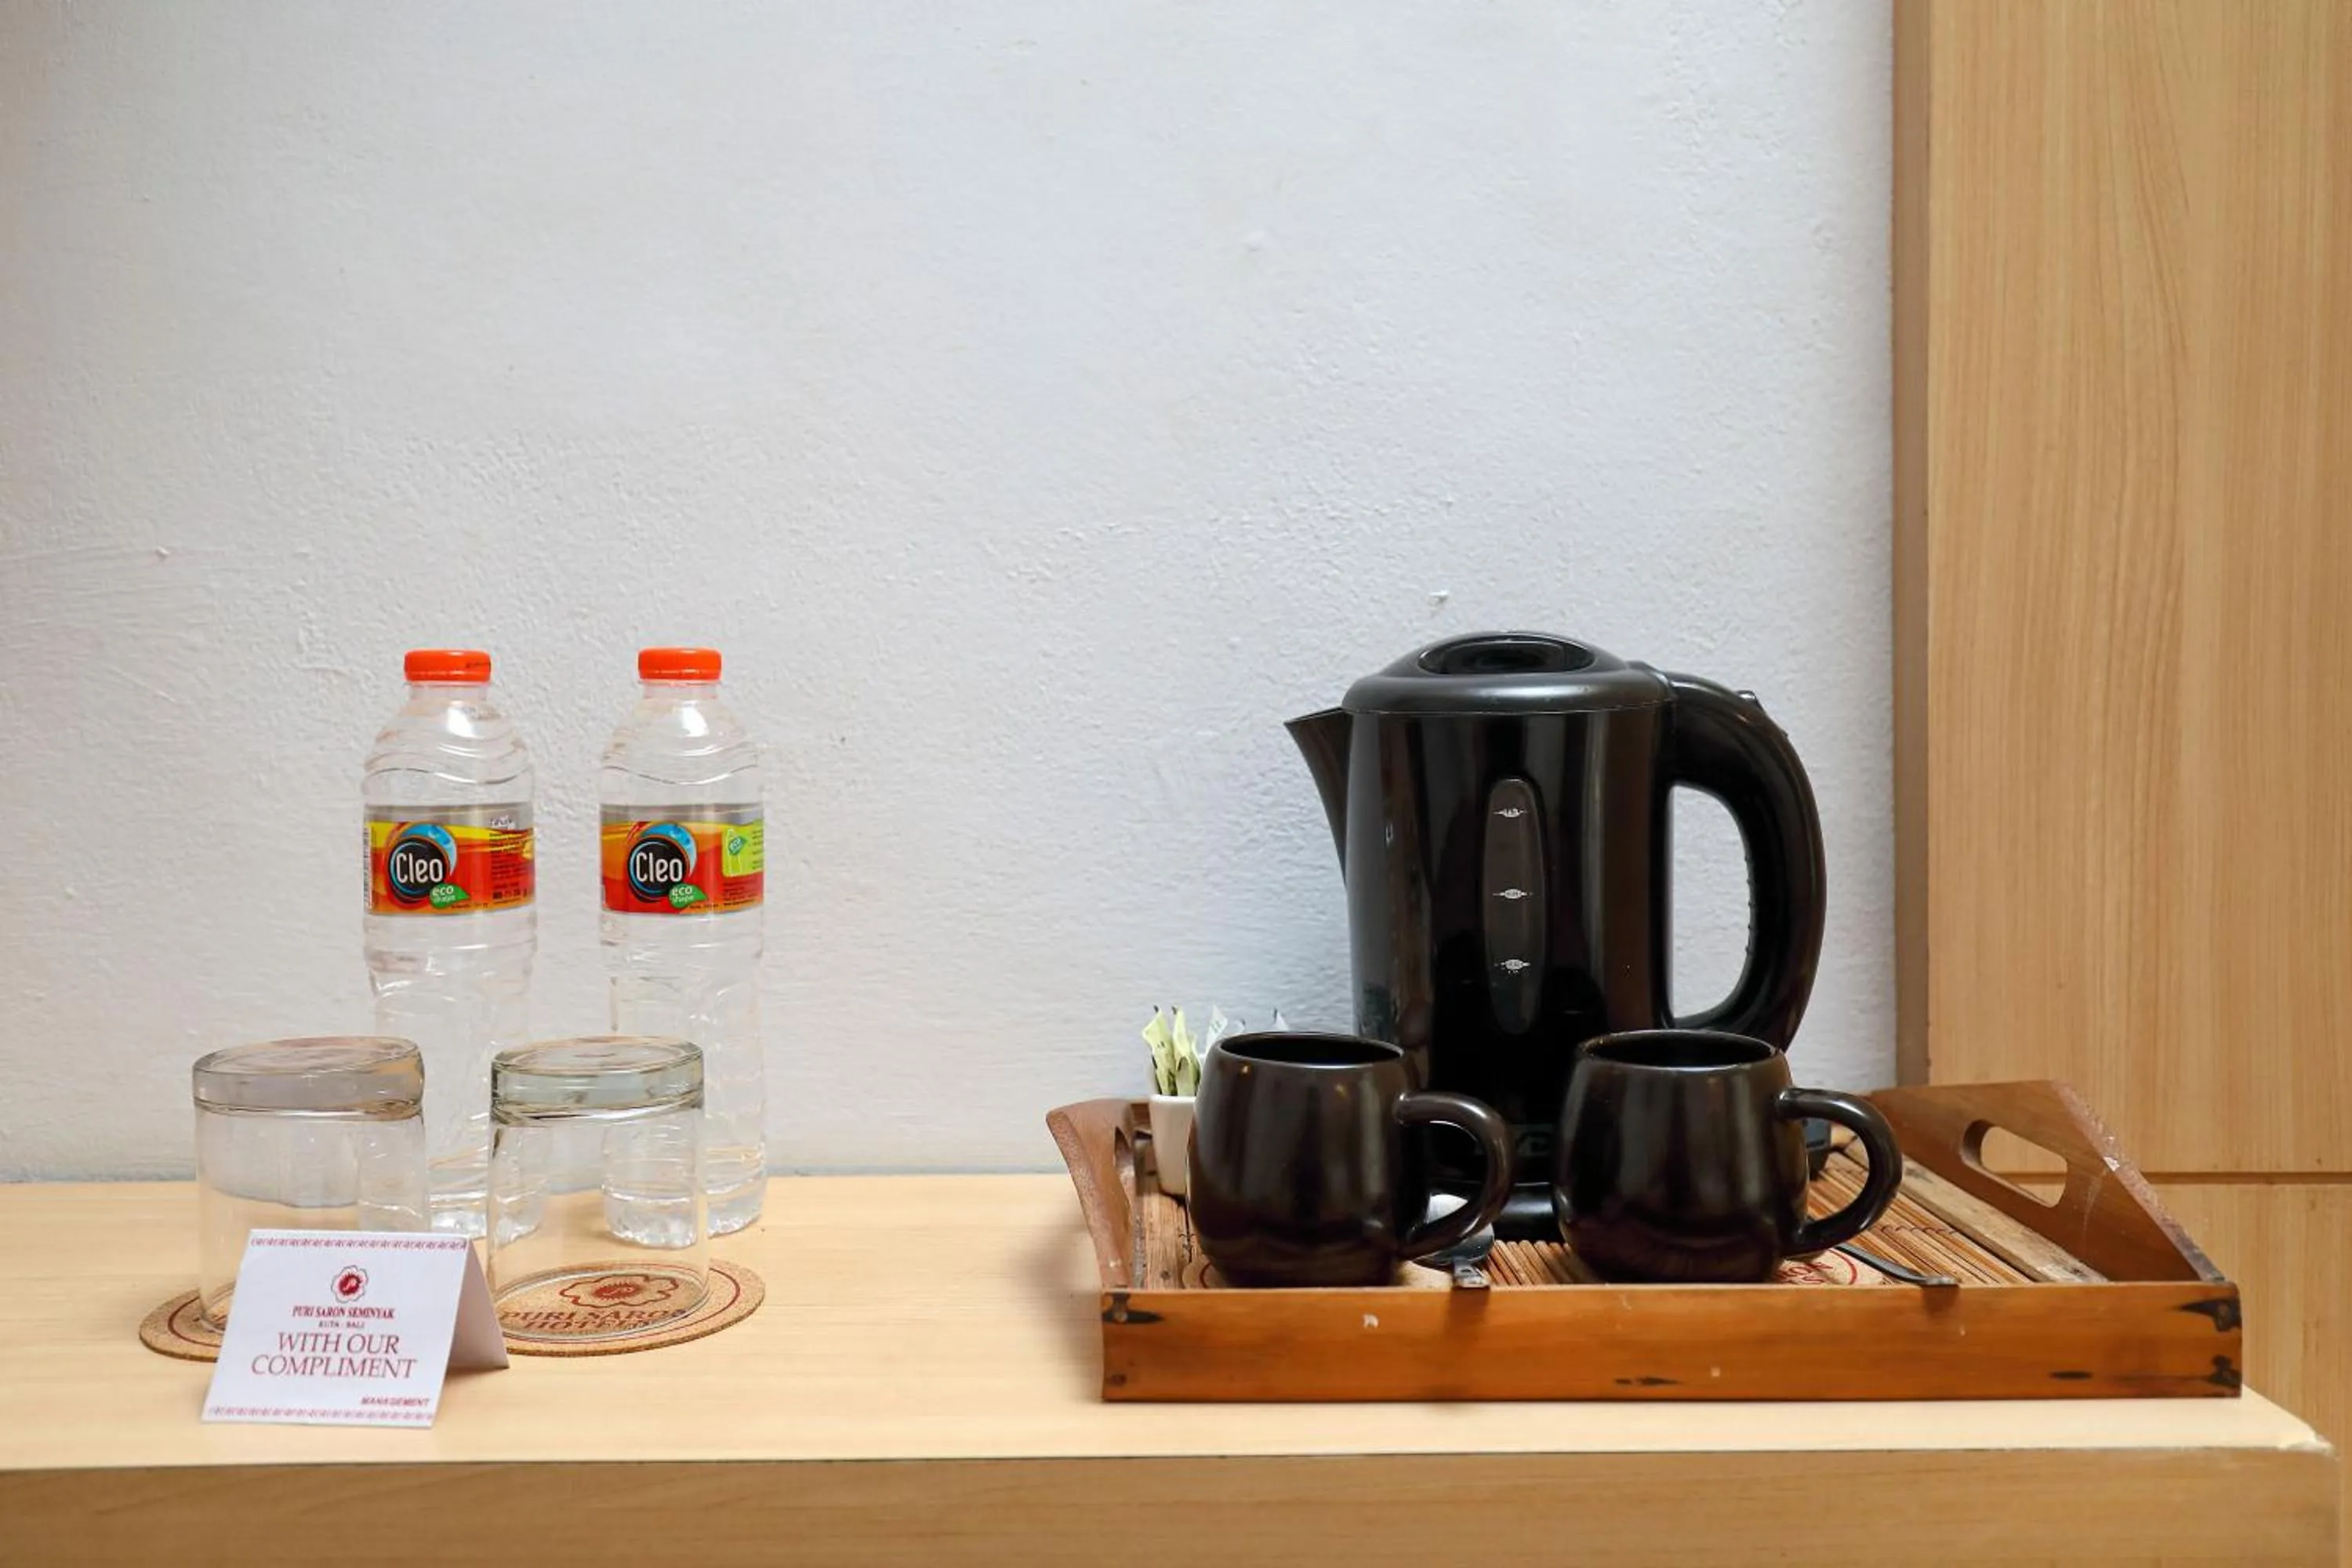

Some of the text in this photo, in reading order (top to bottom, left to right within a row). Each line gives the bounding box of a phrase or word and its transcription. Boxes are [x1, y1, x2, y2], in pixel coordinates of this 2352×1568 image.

[396, 852, 443, 884] Cleo
[636, 852, 683, 883] Cleo
[432, 886, 455, 895] eco
[671, 885, 692, 895] eco
[292, 1306, 395, 1319] PURI SARON SEMINYAK
[499, 1311, 577, 1321] PURI
[347, 1320, 365, 1329] BALI
[278, 1333, 399, 1354] WITH OUR
[251, 1355, 417, 1379] COMPLIMENT
[361, 1397, 430, 1406] MANAGEMENT
